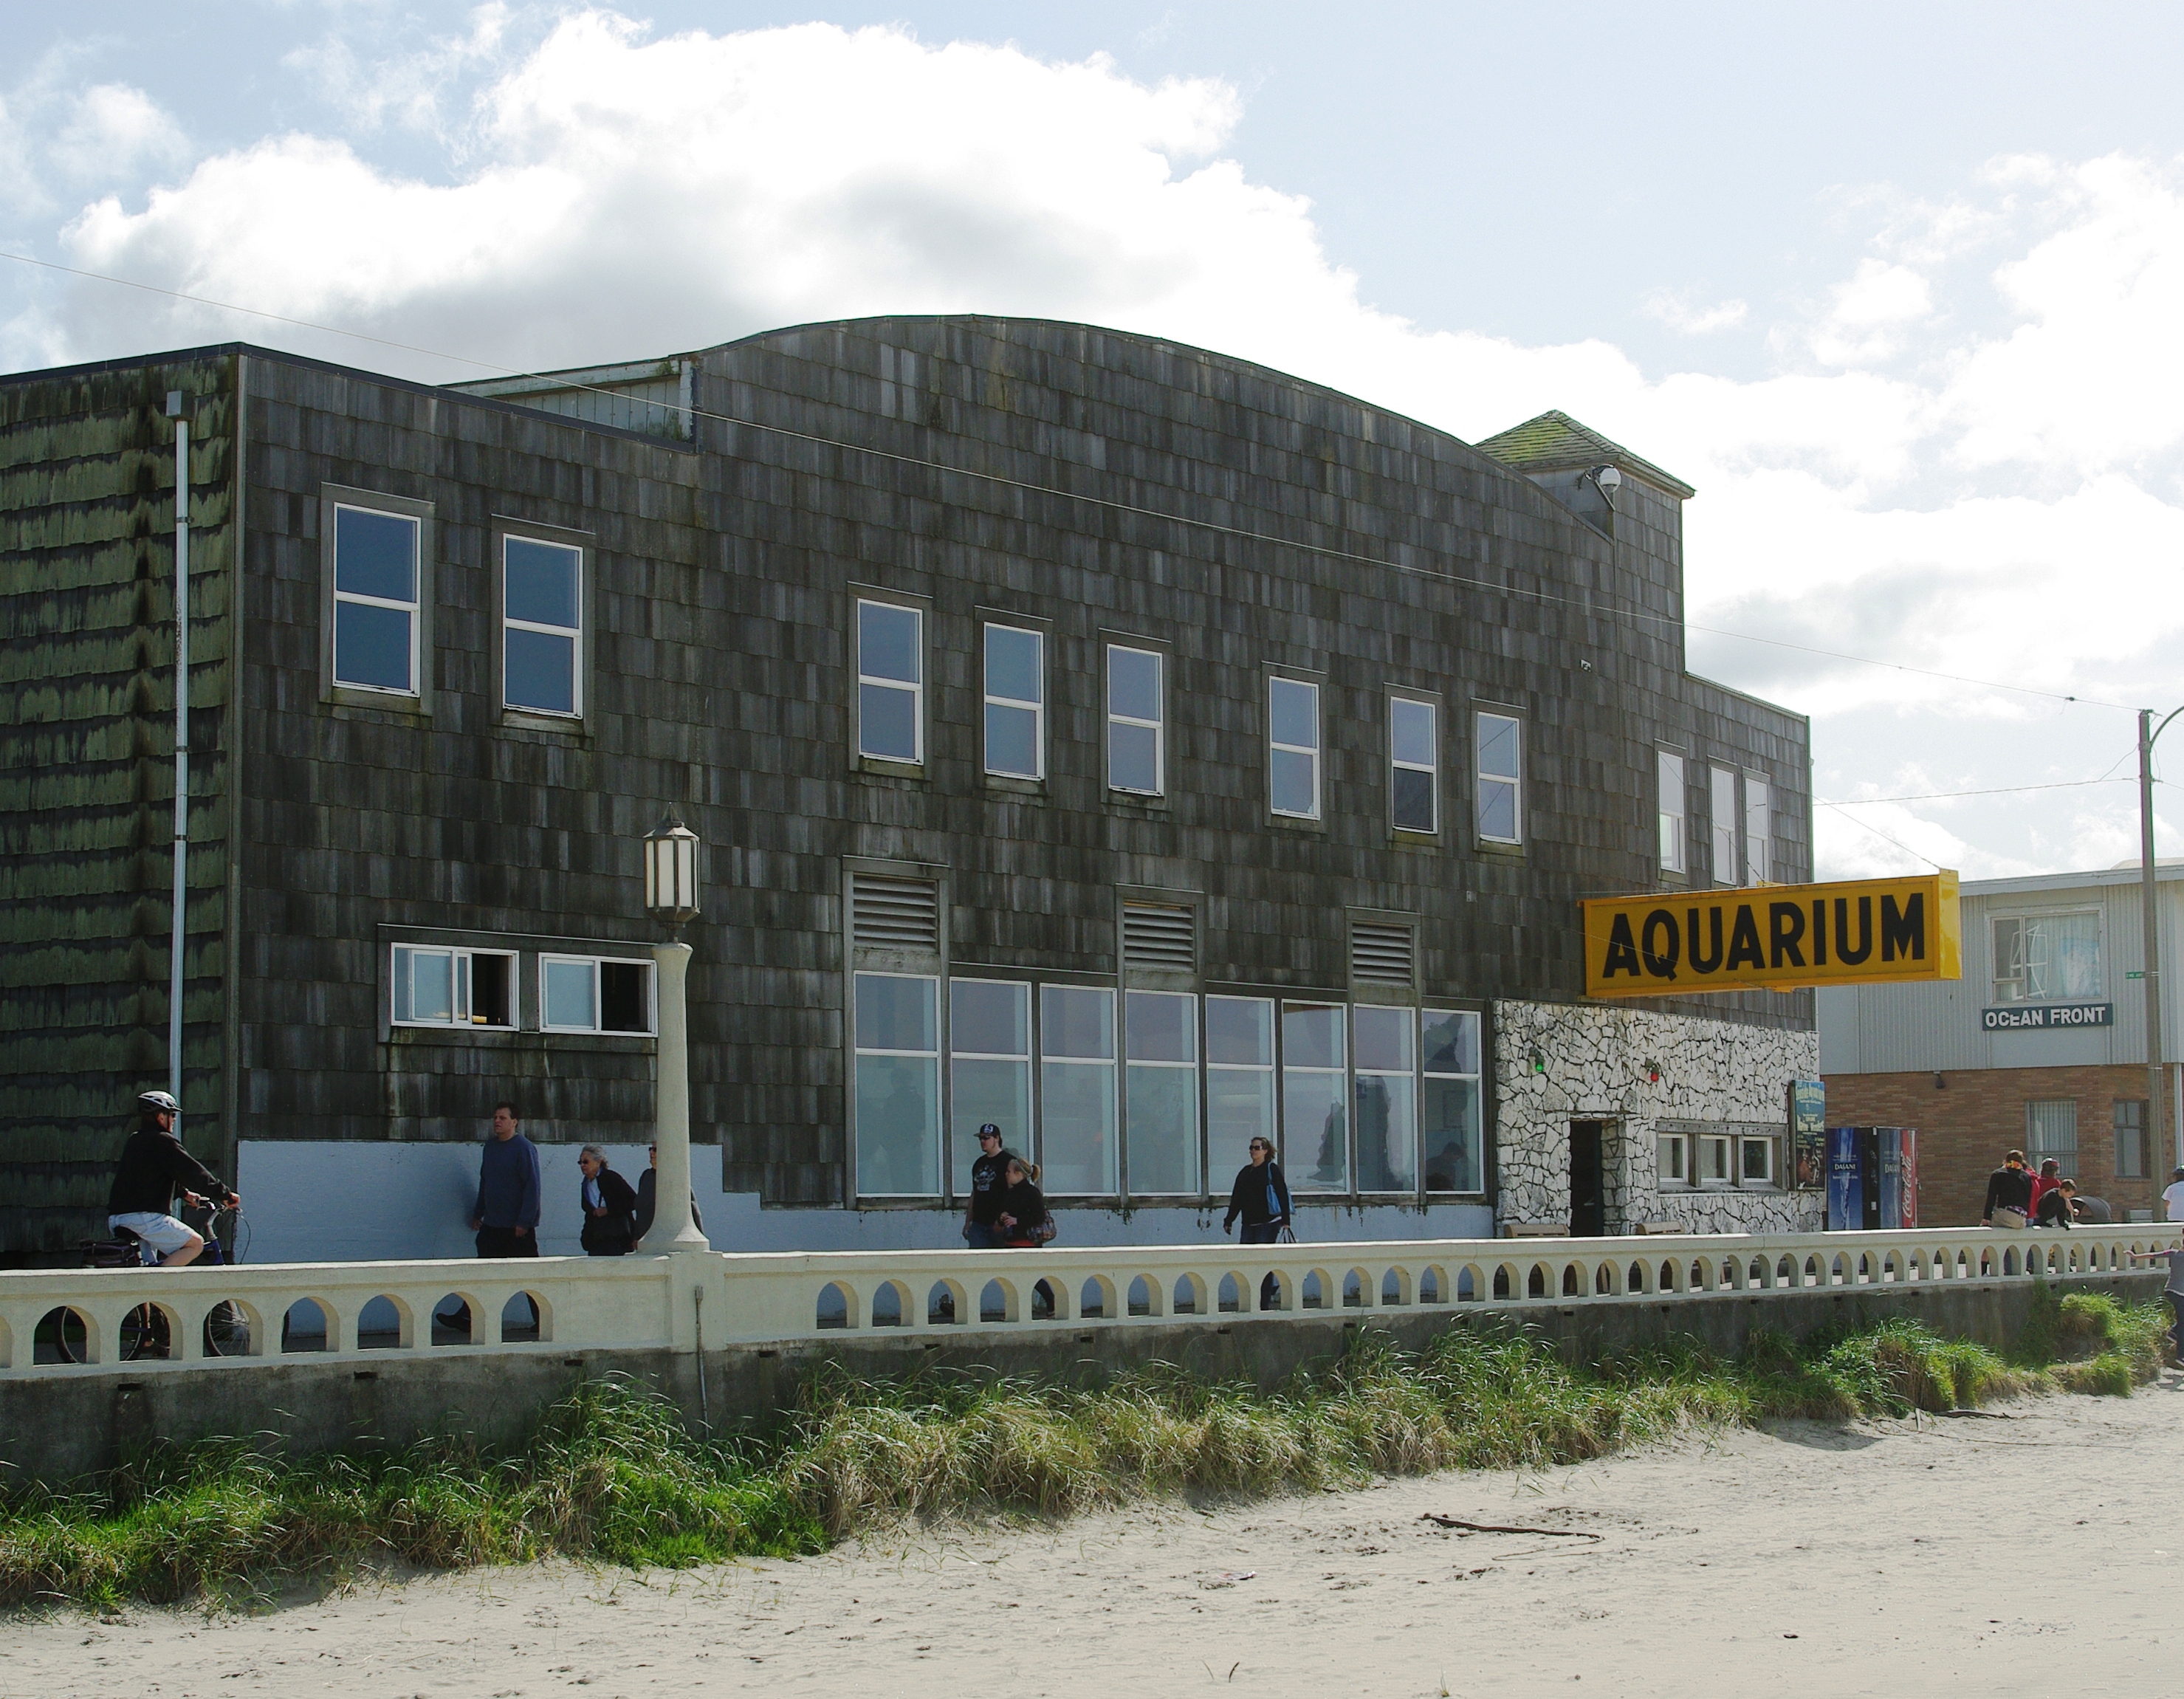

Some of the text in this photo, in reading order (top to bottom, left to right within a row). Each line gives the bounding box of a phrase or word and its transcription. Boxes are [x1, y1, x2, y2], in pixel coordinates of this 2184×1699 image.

[1602, 892, 1925, 982] AQUARIUM
[1985, 1006, 2106, 1028] OCEAN FRONT
